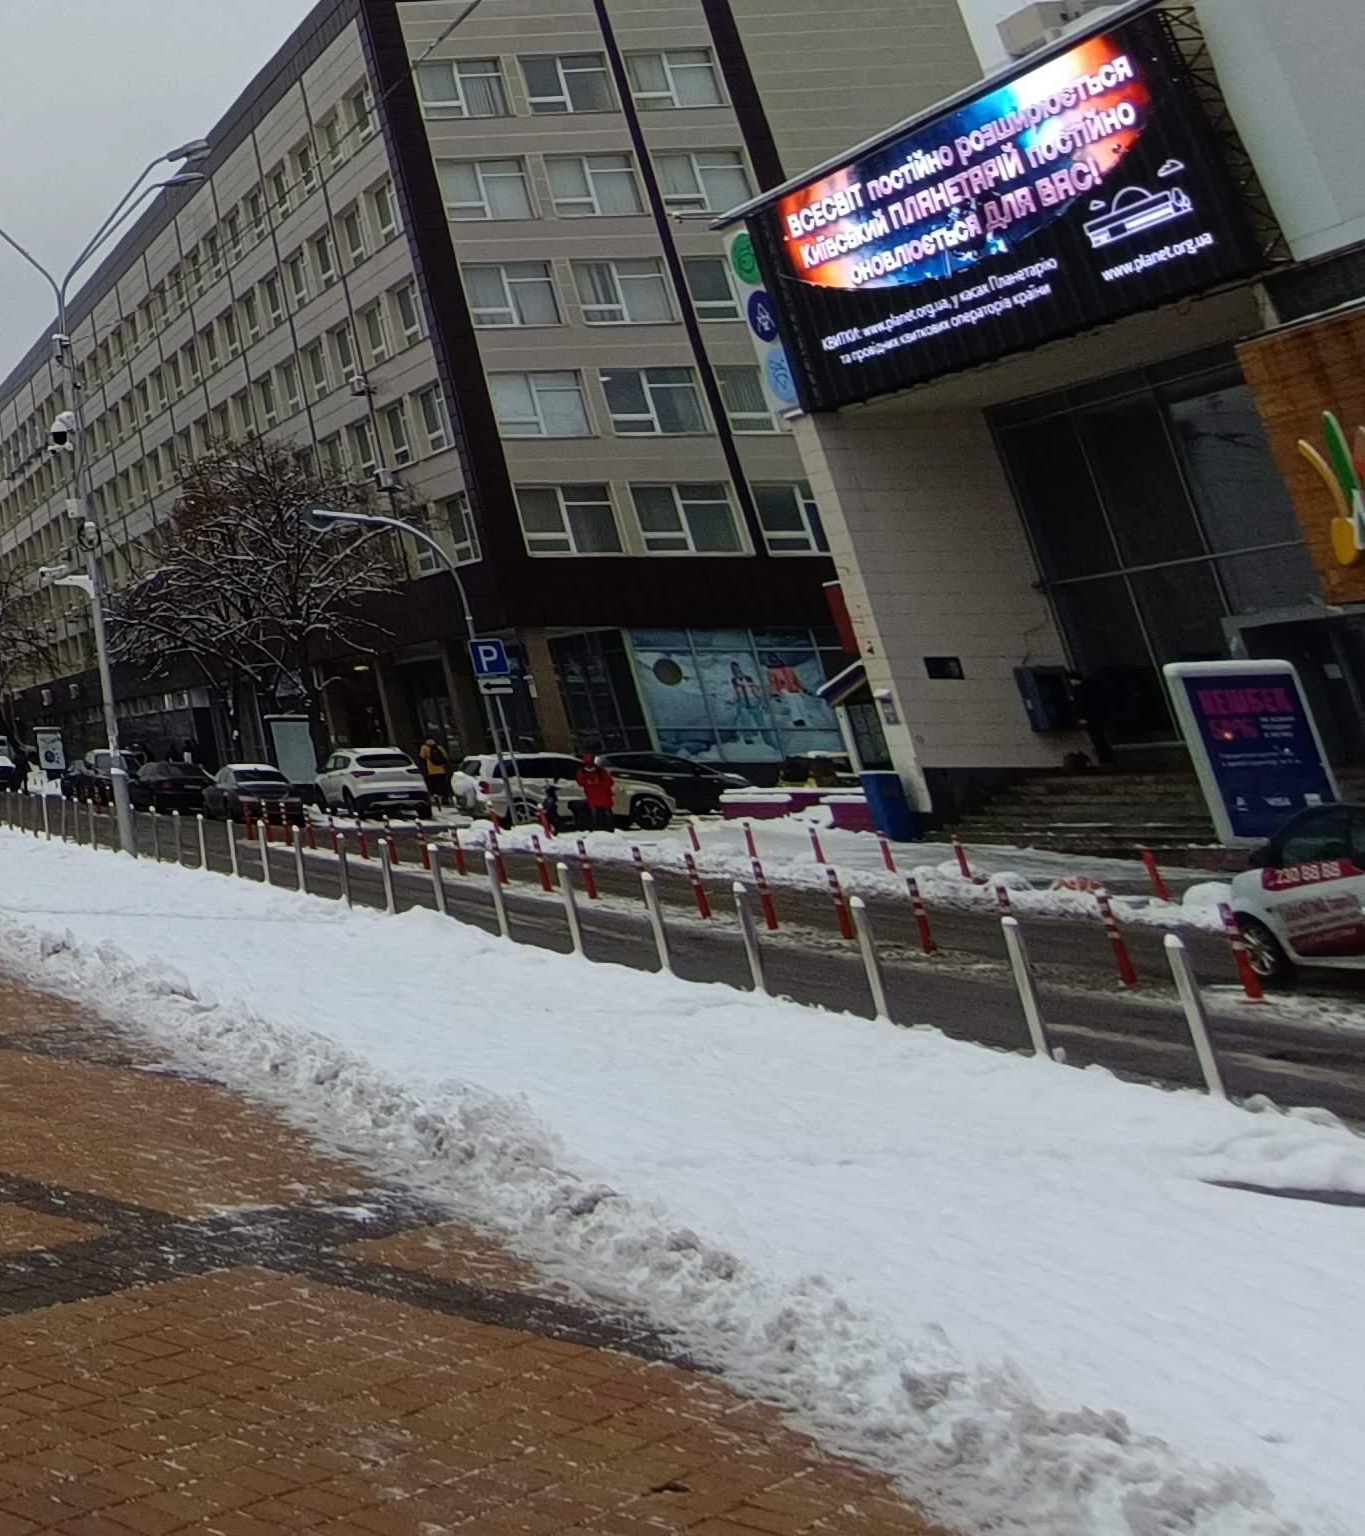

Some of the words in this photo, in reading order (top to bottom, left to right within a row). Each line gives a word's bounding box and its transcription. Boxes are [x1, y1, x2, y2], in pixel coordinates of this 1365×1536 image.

[786, 182, 864, 238] ВСЕСВІТ
[867, 145, 954, 202] постійно
[954, 56, 1134, 165] розширюється
[799, 208, 890, 268] Київський
[887, 142, 1025, 229] ПЛАНЕТАРІЙ
[1025, 102, 1136, 168] постійно
[850, 213, 983, 285] оновлюється
[983, 187, 1036, 232] ДЛЯ
[1035, 157, 1103, 207] ВАС!
[1100, 231, 1214, 282] www.planet.org.ua
[959, 283, 990, 302] касах
[988, 256, 1059, 292] Планетарію
[839, 352, 852, 364] та
[1012, 282, 1052, 308] країни
[478, 645, 498, 672] P
